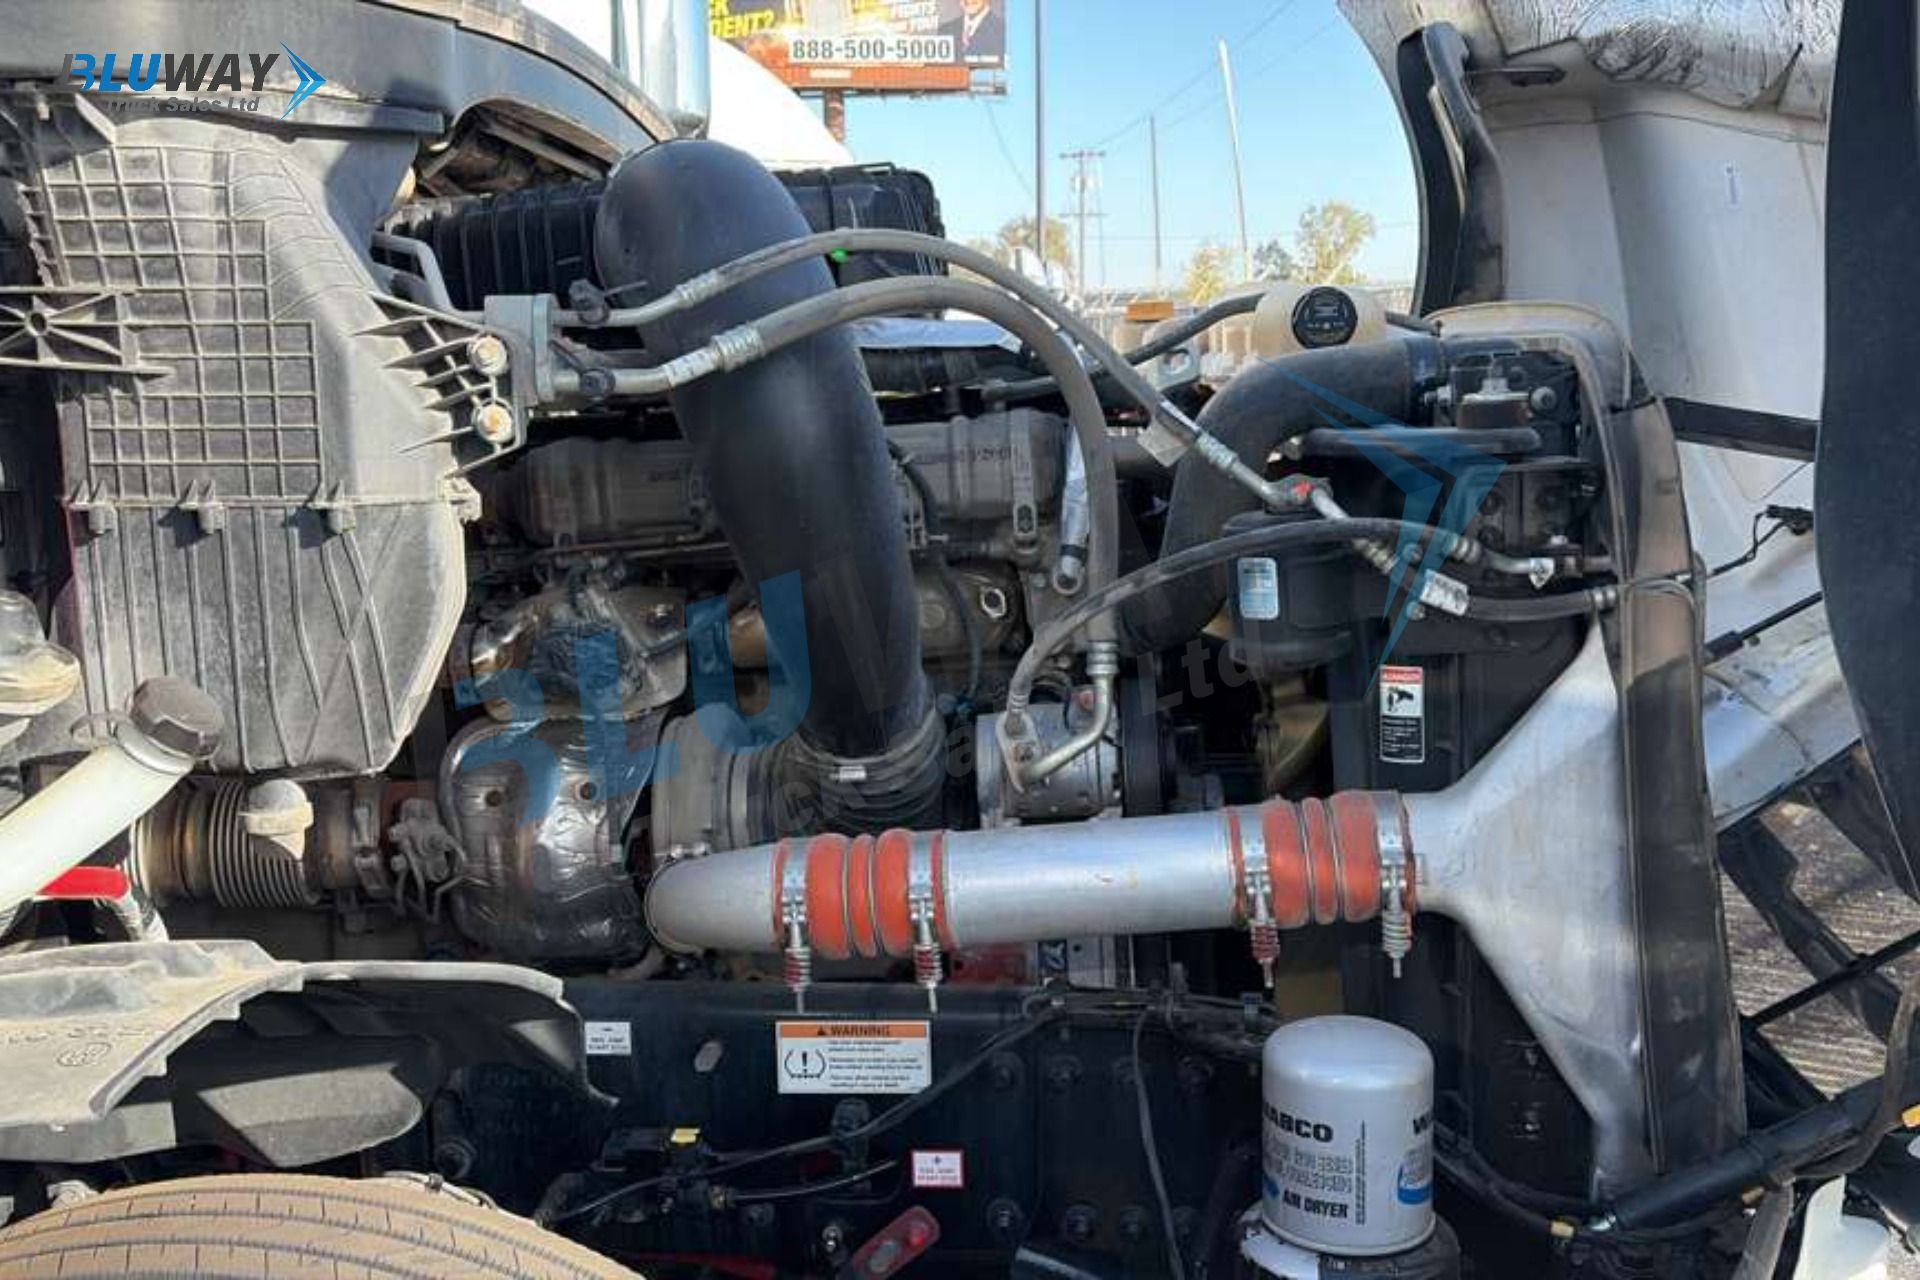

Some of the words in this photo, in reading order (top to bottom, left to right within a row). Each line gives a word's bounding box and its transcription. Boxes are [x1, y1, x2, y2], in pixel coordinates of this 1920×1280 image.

[793, 40, 950, 59] 888-500-5000
[831, 1024, 889, 1036] WARNING
[1304, 1197, 1348, 1218] DRYER
